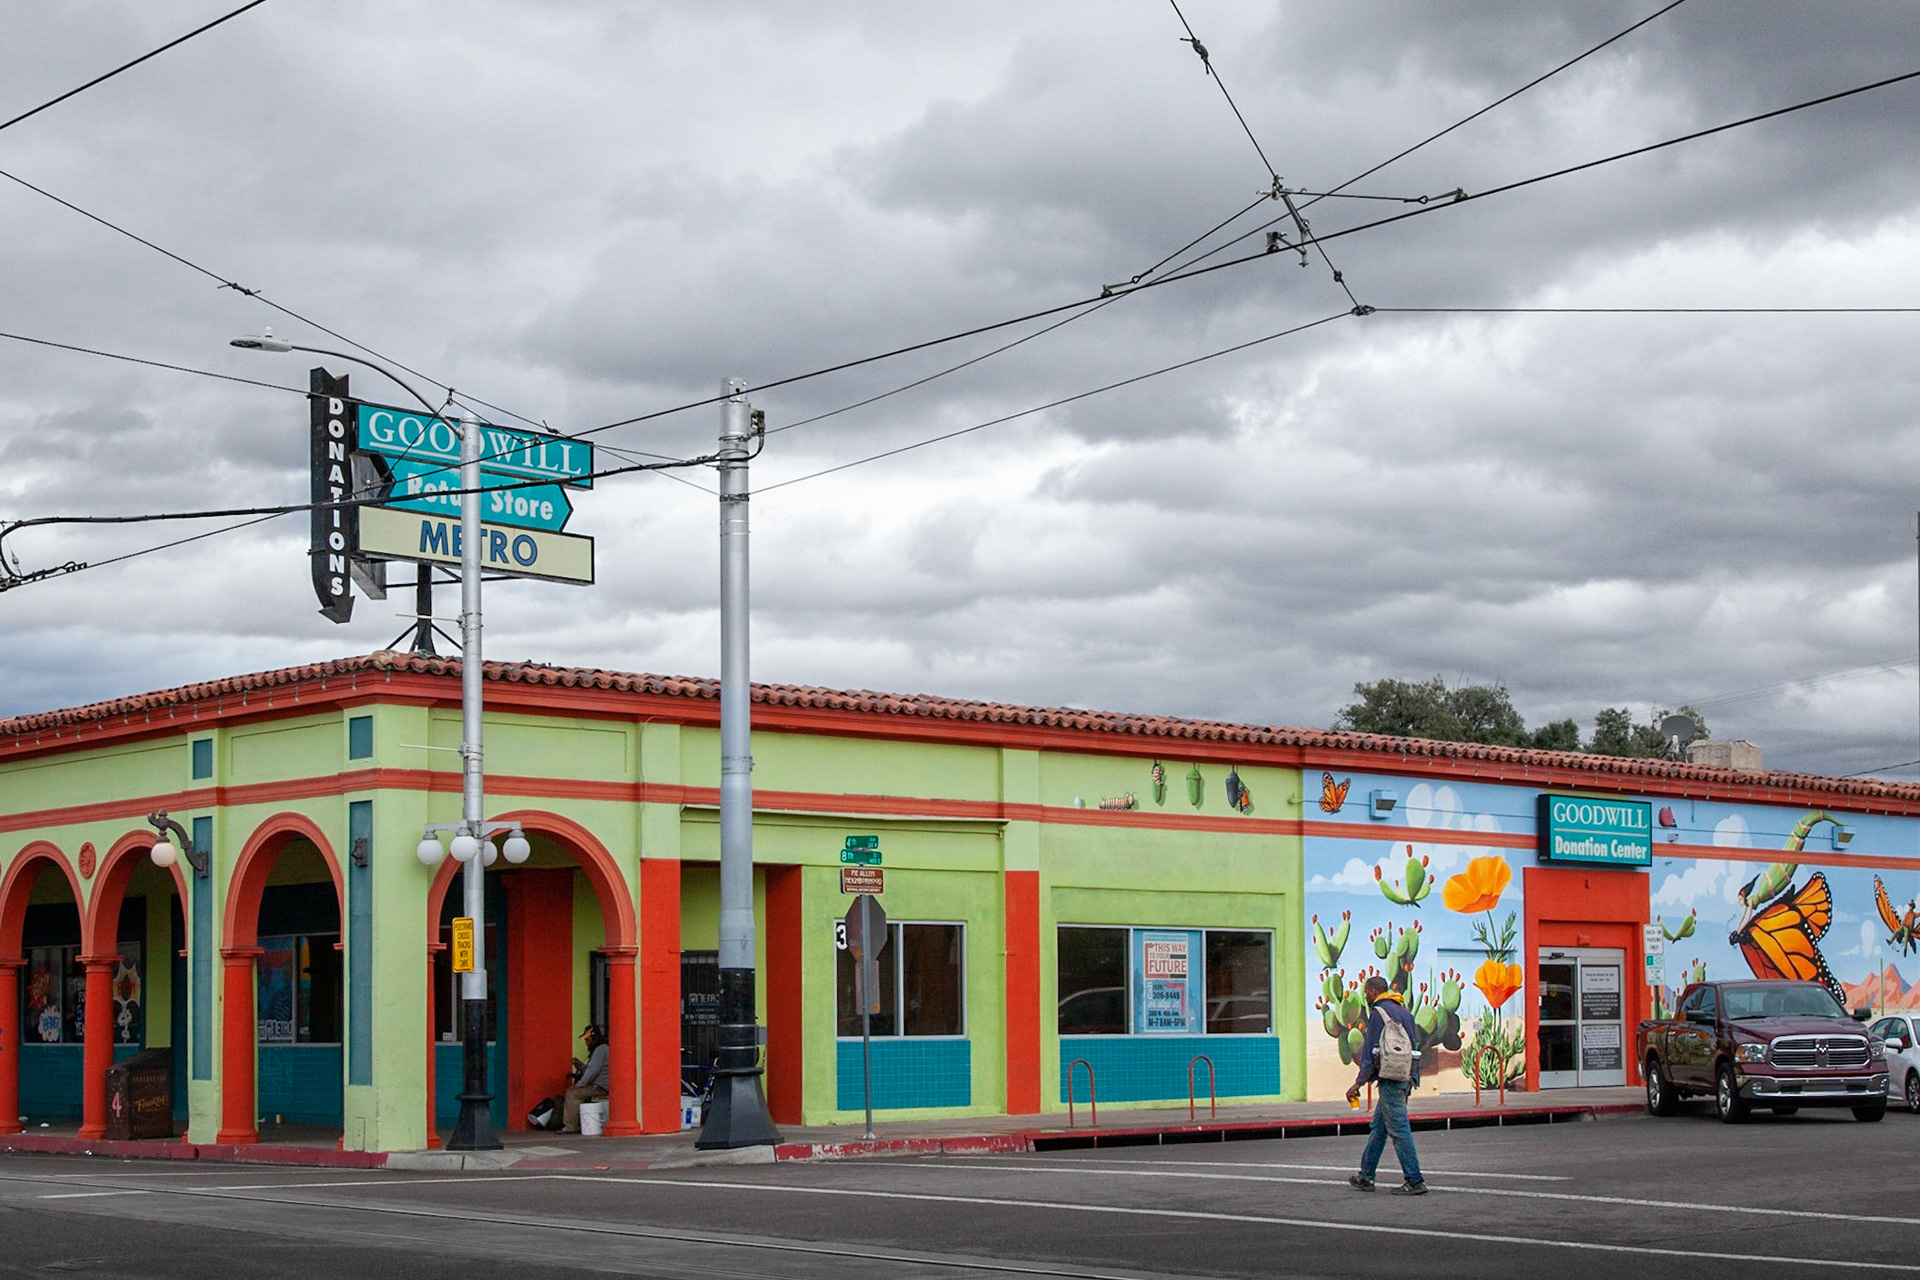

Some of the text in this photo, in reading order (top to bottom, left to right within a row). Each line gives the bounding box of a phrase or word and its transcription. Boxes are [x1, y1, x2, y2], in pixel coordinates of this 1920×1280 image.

[368, 411, 582, 475] GOOWILL
[328, 397, 345, 596] DONATIONS
[407, 472, 554, 520] Reta Store
[419, 520, 538, 566] MERO
[1553, 802, 1648, 829] GOODWILL
[842, 851, 853, 861] 8th
[1555, 835, 1648, 860] Donation Center
[456, 941, 471, 949] TRACKS
[1154, 943, 1187, 953] THIS WAY
[1156, 952, 1170, 960] YOUR
[1149, 960, 1187, 973] FUTURE
